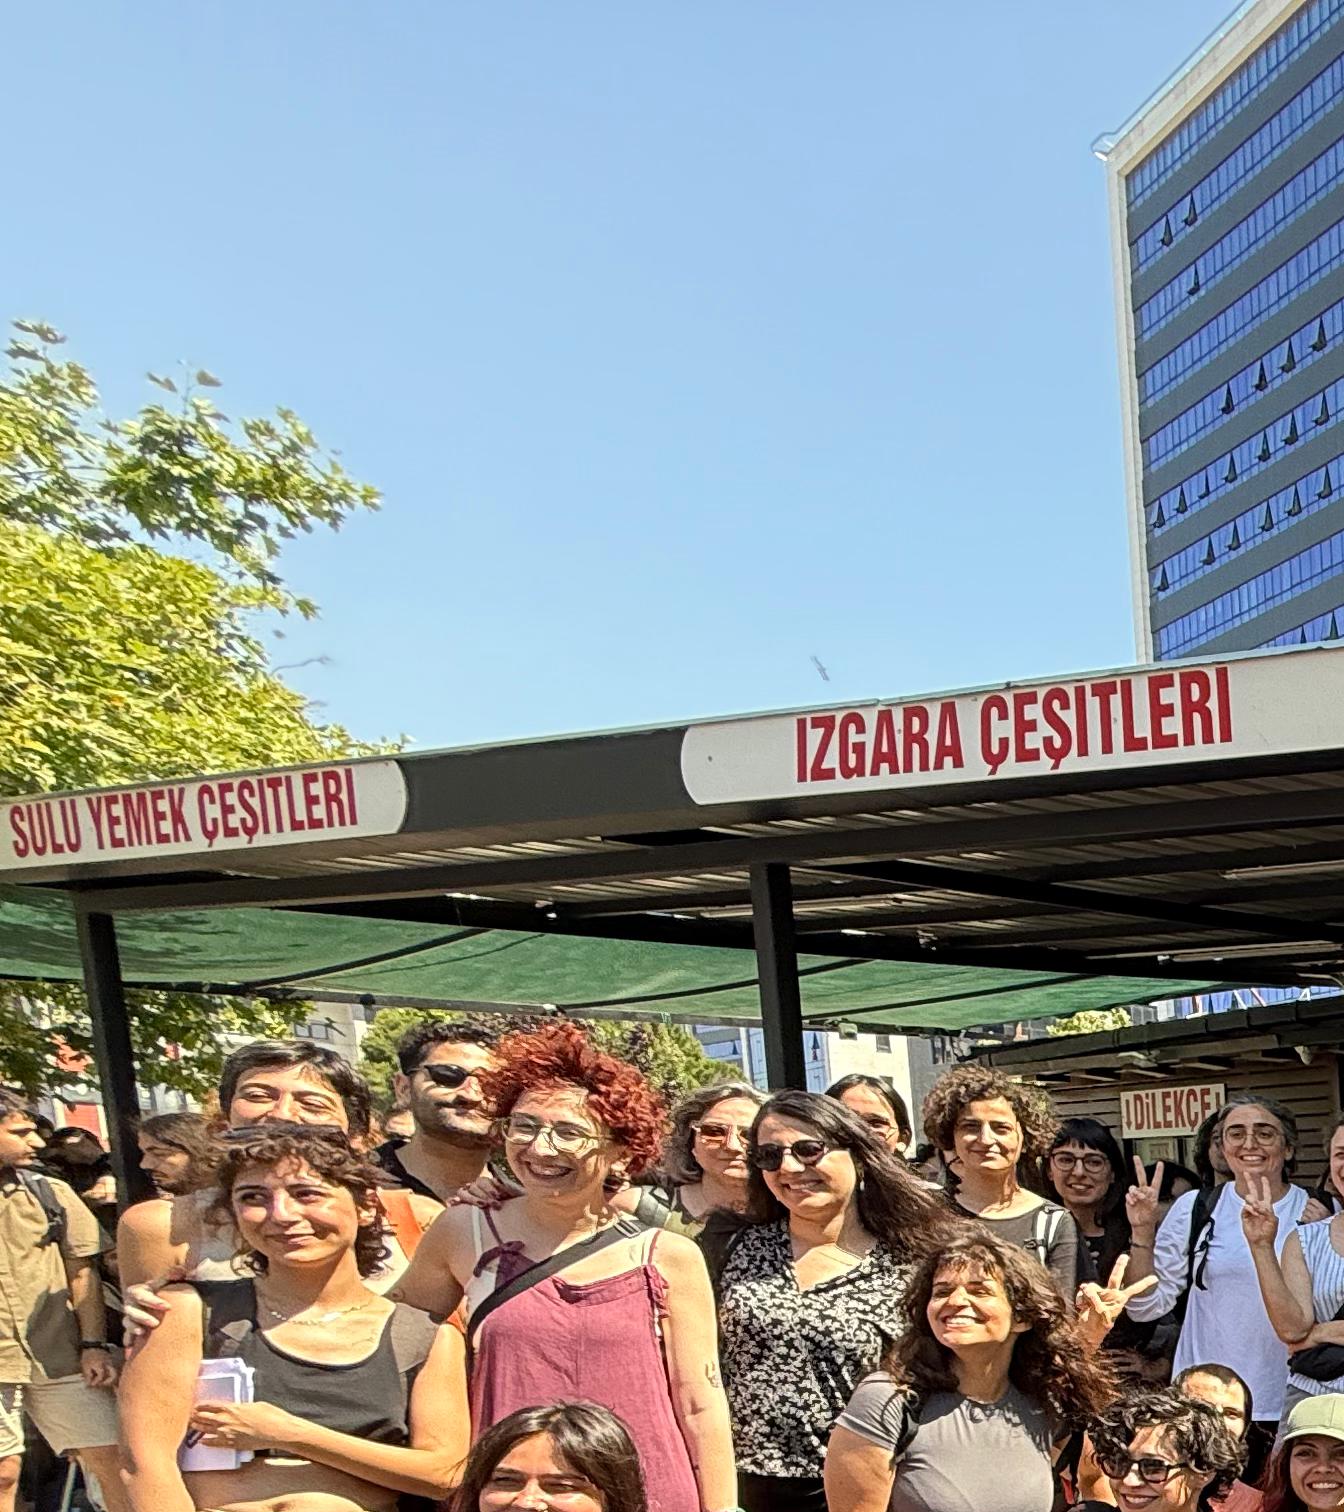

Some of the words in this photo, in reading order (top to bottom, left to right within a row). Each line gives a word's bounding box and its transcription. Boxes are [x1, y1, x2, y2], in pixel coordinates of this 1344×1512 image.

[797, 701, 965, 783] IZGARA
[10, 801, 82, 858] SULU
[88, 786, 192, 850] YEMEK
